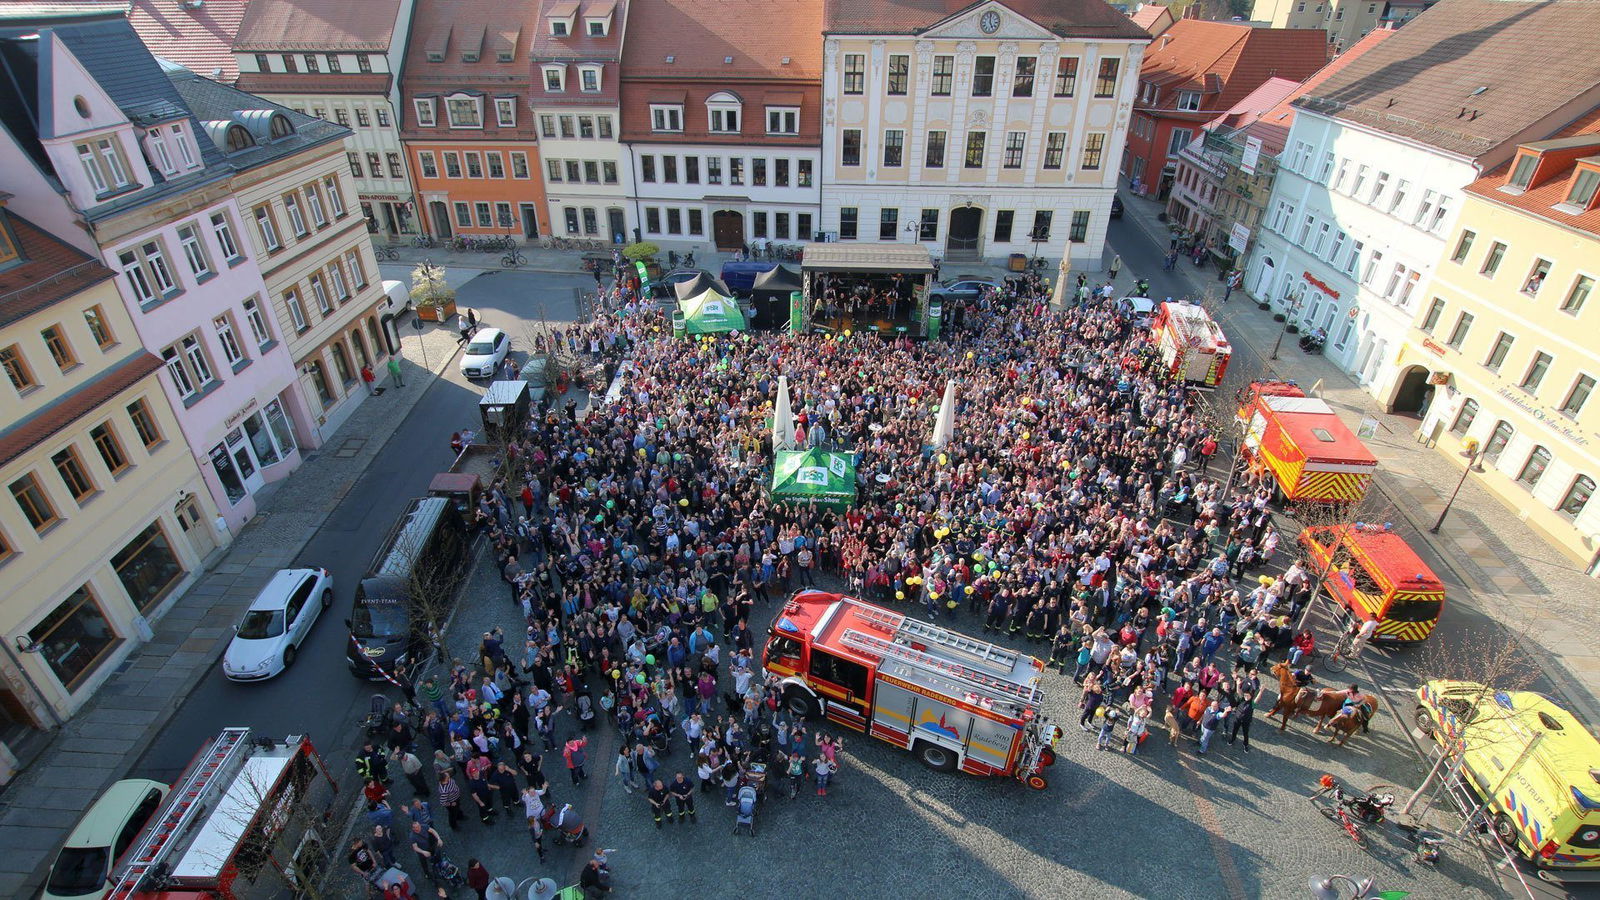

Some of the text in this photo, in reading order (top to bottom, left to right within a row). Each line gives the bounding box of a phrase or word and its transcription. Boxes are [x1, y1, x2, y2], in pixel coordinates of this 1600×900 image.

[803, 469, 825, 482] PSR
[881, 675, 920, 693] FEUERWEHR
[921, 689, 957, 706] RADEBERG
[974, 732, 1008, 751] Radeberg
[994, 733, 1011, 742] 800
[1516, 772, 1545, 805] NOTRUF
